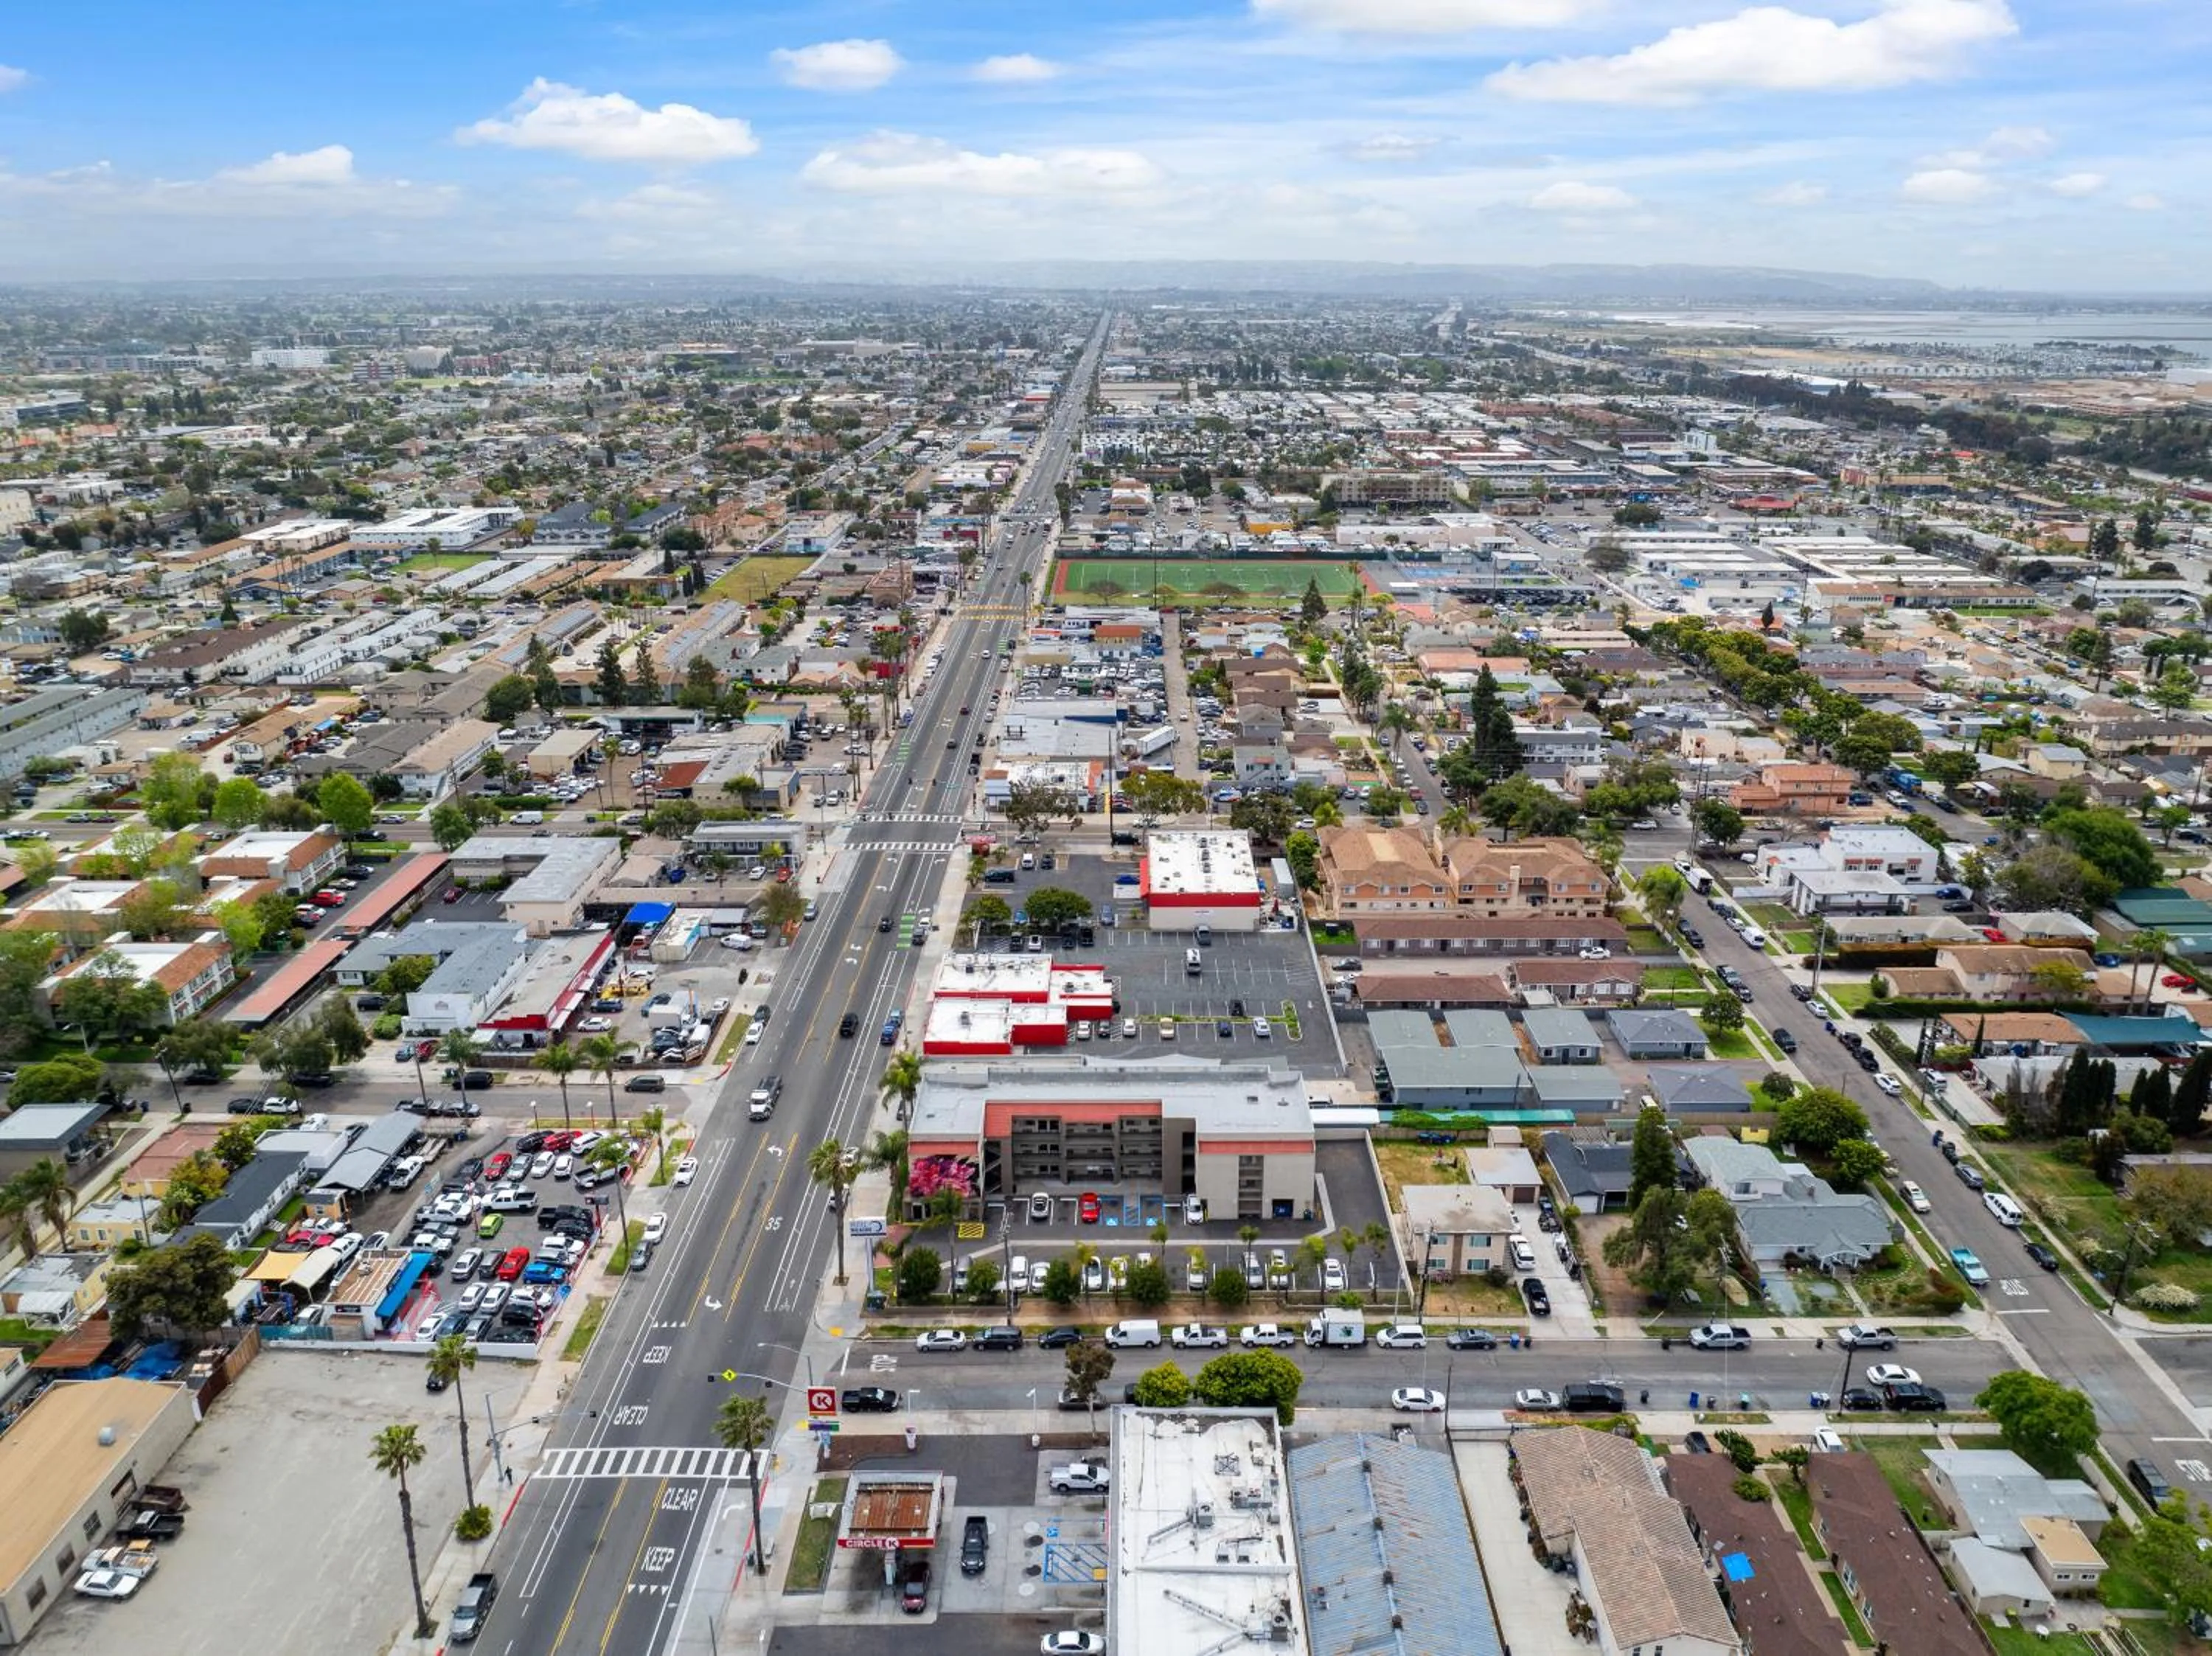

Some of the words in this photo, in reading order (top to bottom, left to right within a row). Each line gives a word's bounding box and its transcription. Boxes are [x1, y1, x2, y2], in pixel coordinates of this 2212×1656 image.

[765, 1217, 783, 1231] 35
[643, 1345, 672, 1363] KEEP
[613, 1405, 649, 1425] CLEAR
[661, 1487, 699, 1511] CLEAR
[846, 1539, 883, 1548] CIRCLE
[641, 1546, 676, 1572] KEEP
